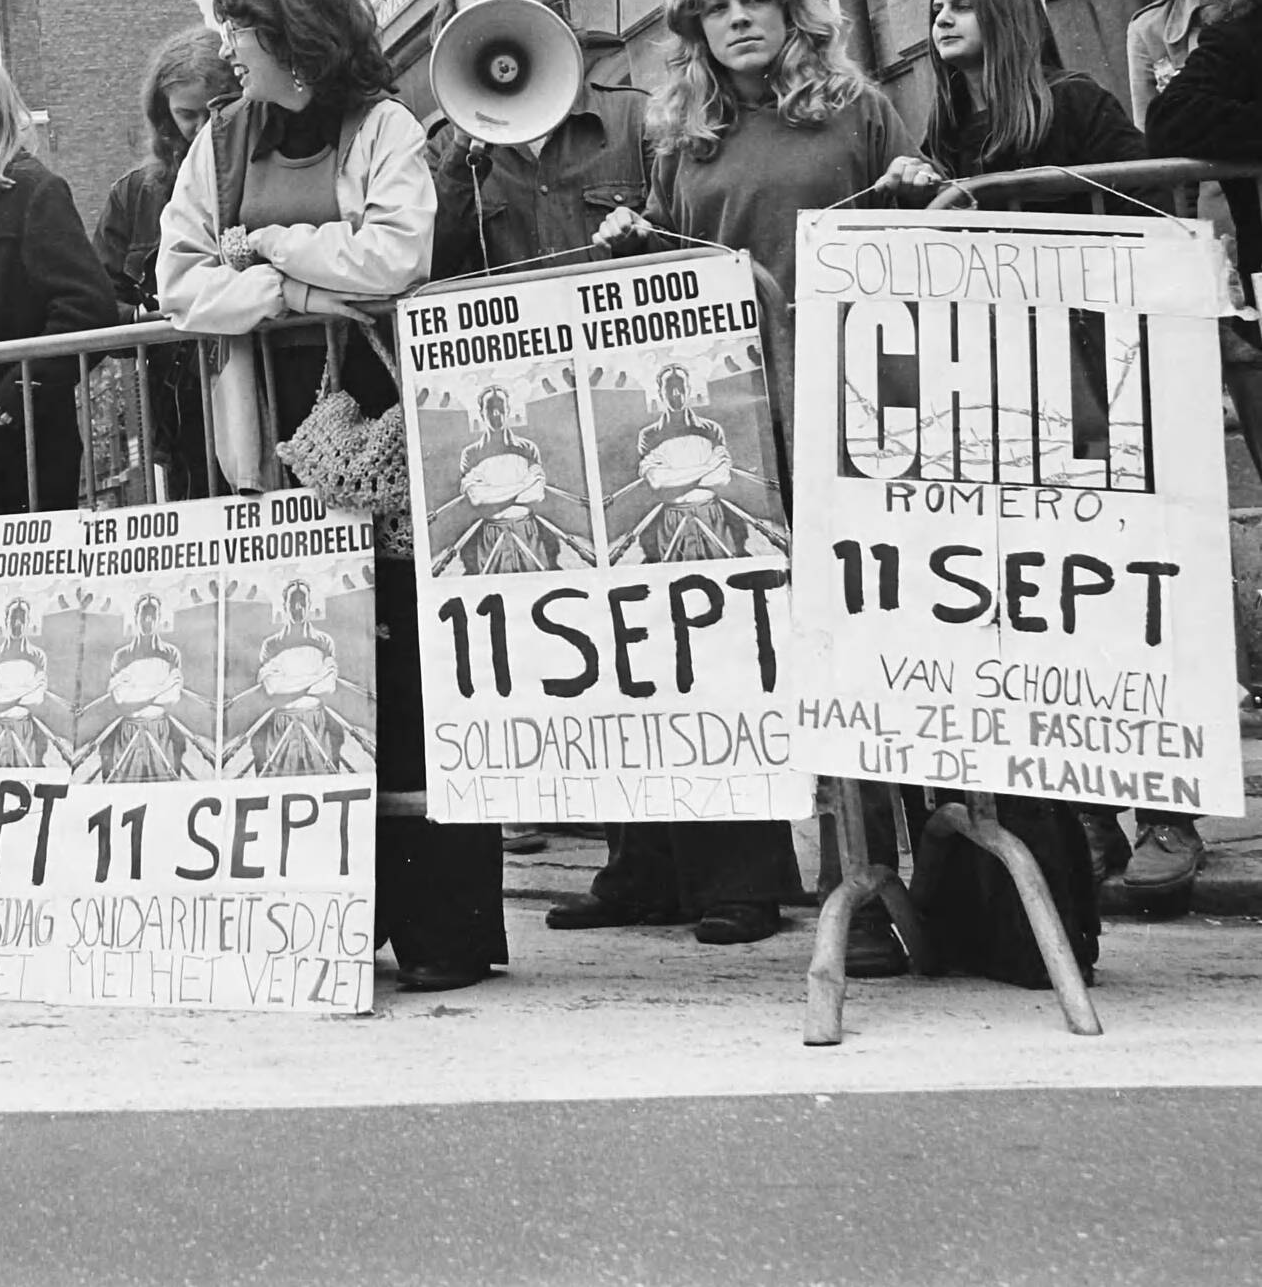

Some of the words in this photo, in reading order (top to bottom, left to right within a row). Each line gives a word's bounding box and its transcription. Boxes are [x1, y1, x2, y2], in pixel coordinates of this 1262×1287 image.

[577, 283, 623, 314] TER
[633, 270, 700, 307] DOOD
[815, 242, 1145, 307] SOLIDARITEIT
[407, 306, 448, 338] TER
[458, 295, 520, 331] DOOD
[582, 299, 758, 351] VEROORDEELD
[410, 323, 574, 372] VEROORDEELD
[844, 300, 1148, 489] CHILI
[3, 519, 52, 546] DOOD
[83, 518, 118, 546] TER
[127, 511, 178, 541] DOOD
[224, 502, 261, 531] TER
[271, 495, 327, 526] DOOD
[886, 481, 1125, 532] ROMERO,
[82, 540, 220, 577] VEROORDEELD
[224, 523, 374, 564] VEROORDEELD
[833, 540, 900, 614] 11
[929, 545, 1180, 647] SEPT
[438, 593, 512, 698] 11
[531, 568, 787, 698] SEPT
[881, 654, 954, 694] VAN
[976, 660, 1167, 717] SCHOUWEN
[435, 711, 790, 772] SOLIDARITEITSDAG
[799, 697, 901, 736] HAAL
[916, 704, 957, 742] ZE
[971, 708, 1011, 746] DE
[1029, 711, 1204, 758] FASCISTEN
[445, 776, 525, 820] MET
[537, 776, 601, 822] HET
[617, 773, 781, 820] VERZET
[859, 737, 914, 774] UIT
[924, 748, 982, 785] DE
[1008, 755, 1200, 808] KLAUWEN
[88, 803, 147, 883] 11
[175, 787, 372, 881] SEPT
[66, 895, 368, 956] SOLIDARITEITSDAG
[69, 949, 141, 999] MET
[149, 950, 223, 1004] HET
